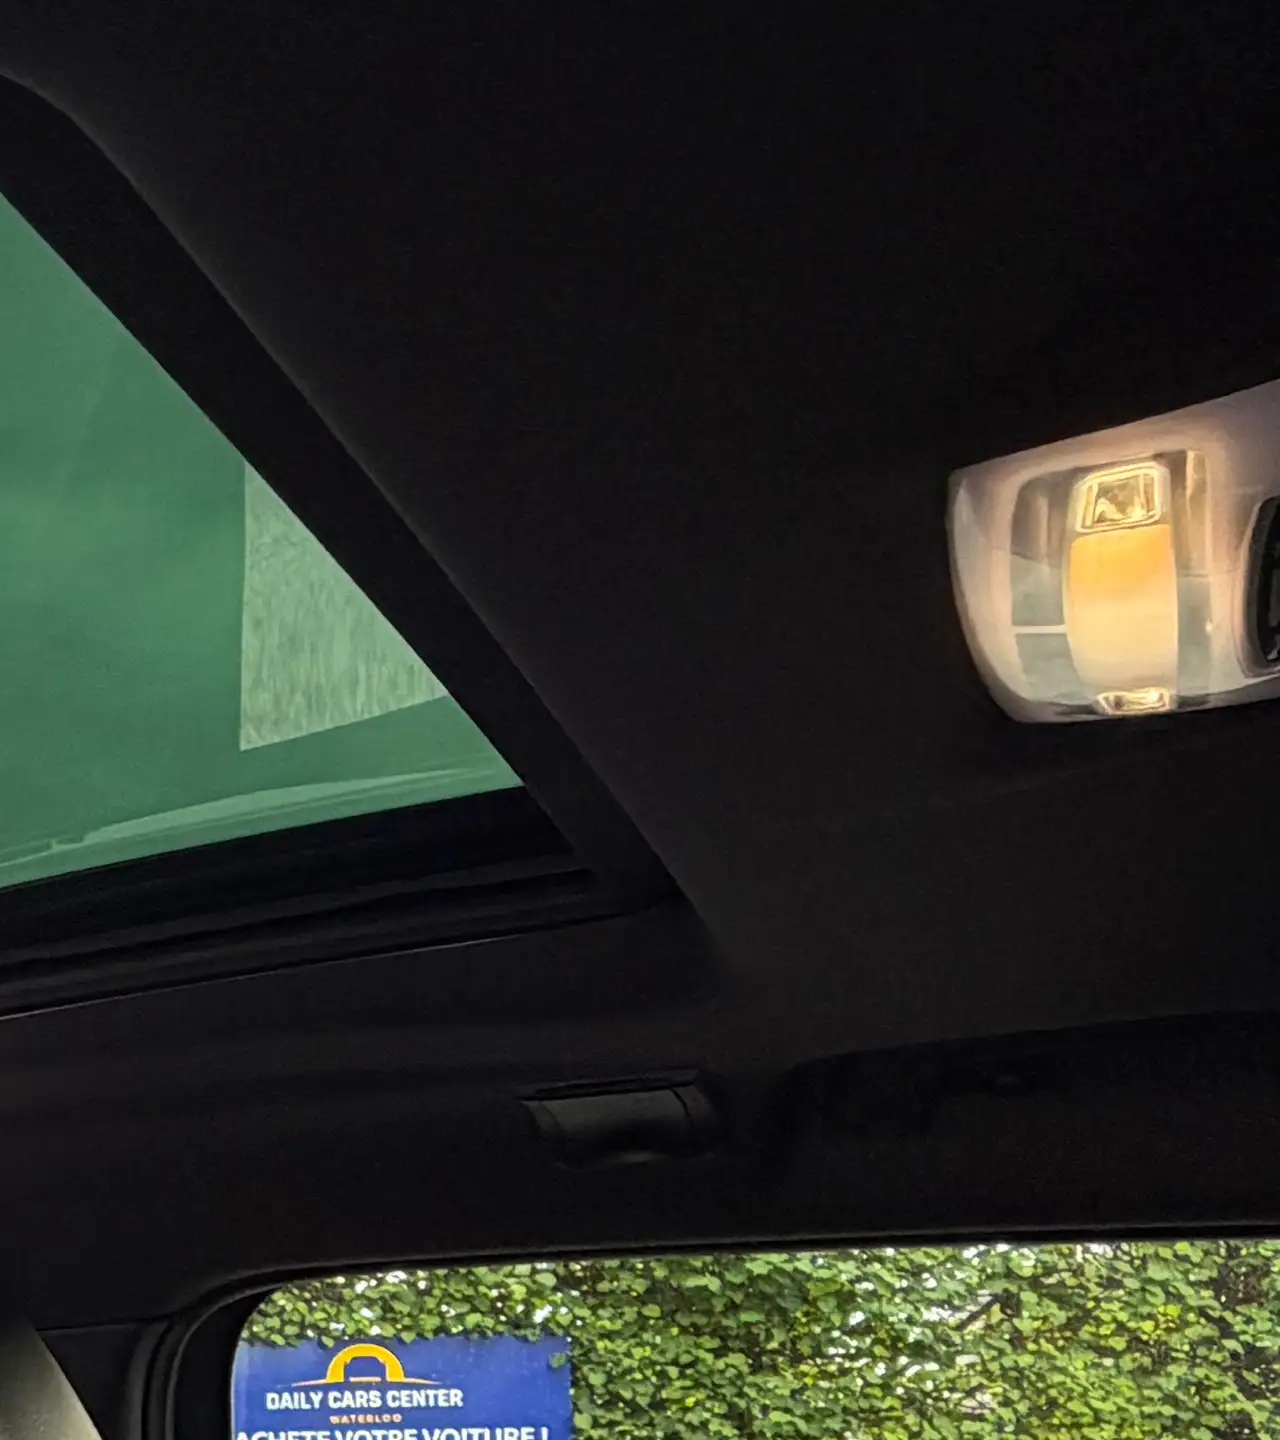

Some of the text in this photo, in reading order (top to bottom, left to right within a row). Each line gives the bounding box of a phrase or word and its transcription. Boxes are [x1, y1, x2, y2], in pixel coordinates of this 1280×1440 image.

[266, 1388, 464, 1410] DAILY CARS CENTER
[329, 1413, 402, 1425] WATERLOO
